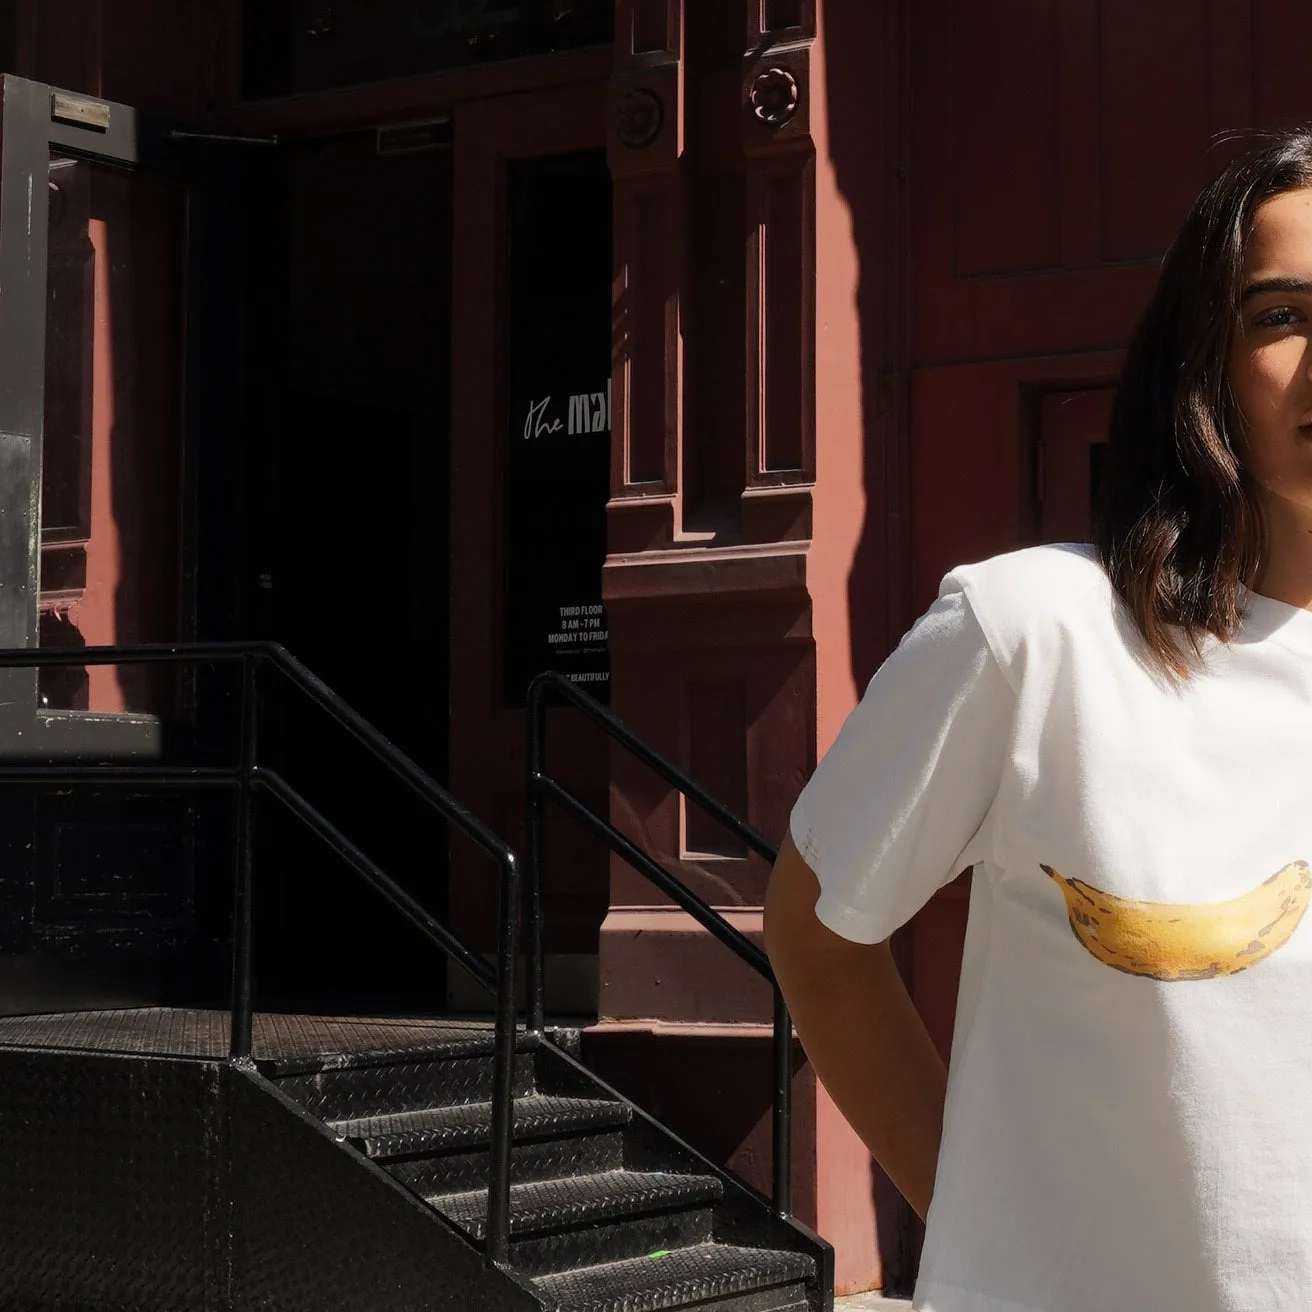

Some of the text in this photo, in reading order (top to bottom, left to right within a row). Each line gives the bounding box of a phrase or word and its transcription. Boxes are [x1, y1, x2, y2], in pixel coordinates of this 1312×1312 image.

[559, 605, 603, 617] THIRD FLOOR
[562, 619, 567, 629] 8
[589, 618, 600, 628] PM
[548, 631, 578, 644] MONDAY
[579, 631, 588, 642] TO
[570, 671, 610, 682] BEAUTIFULLY
